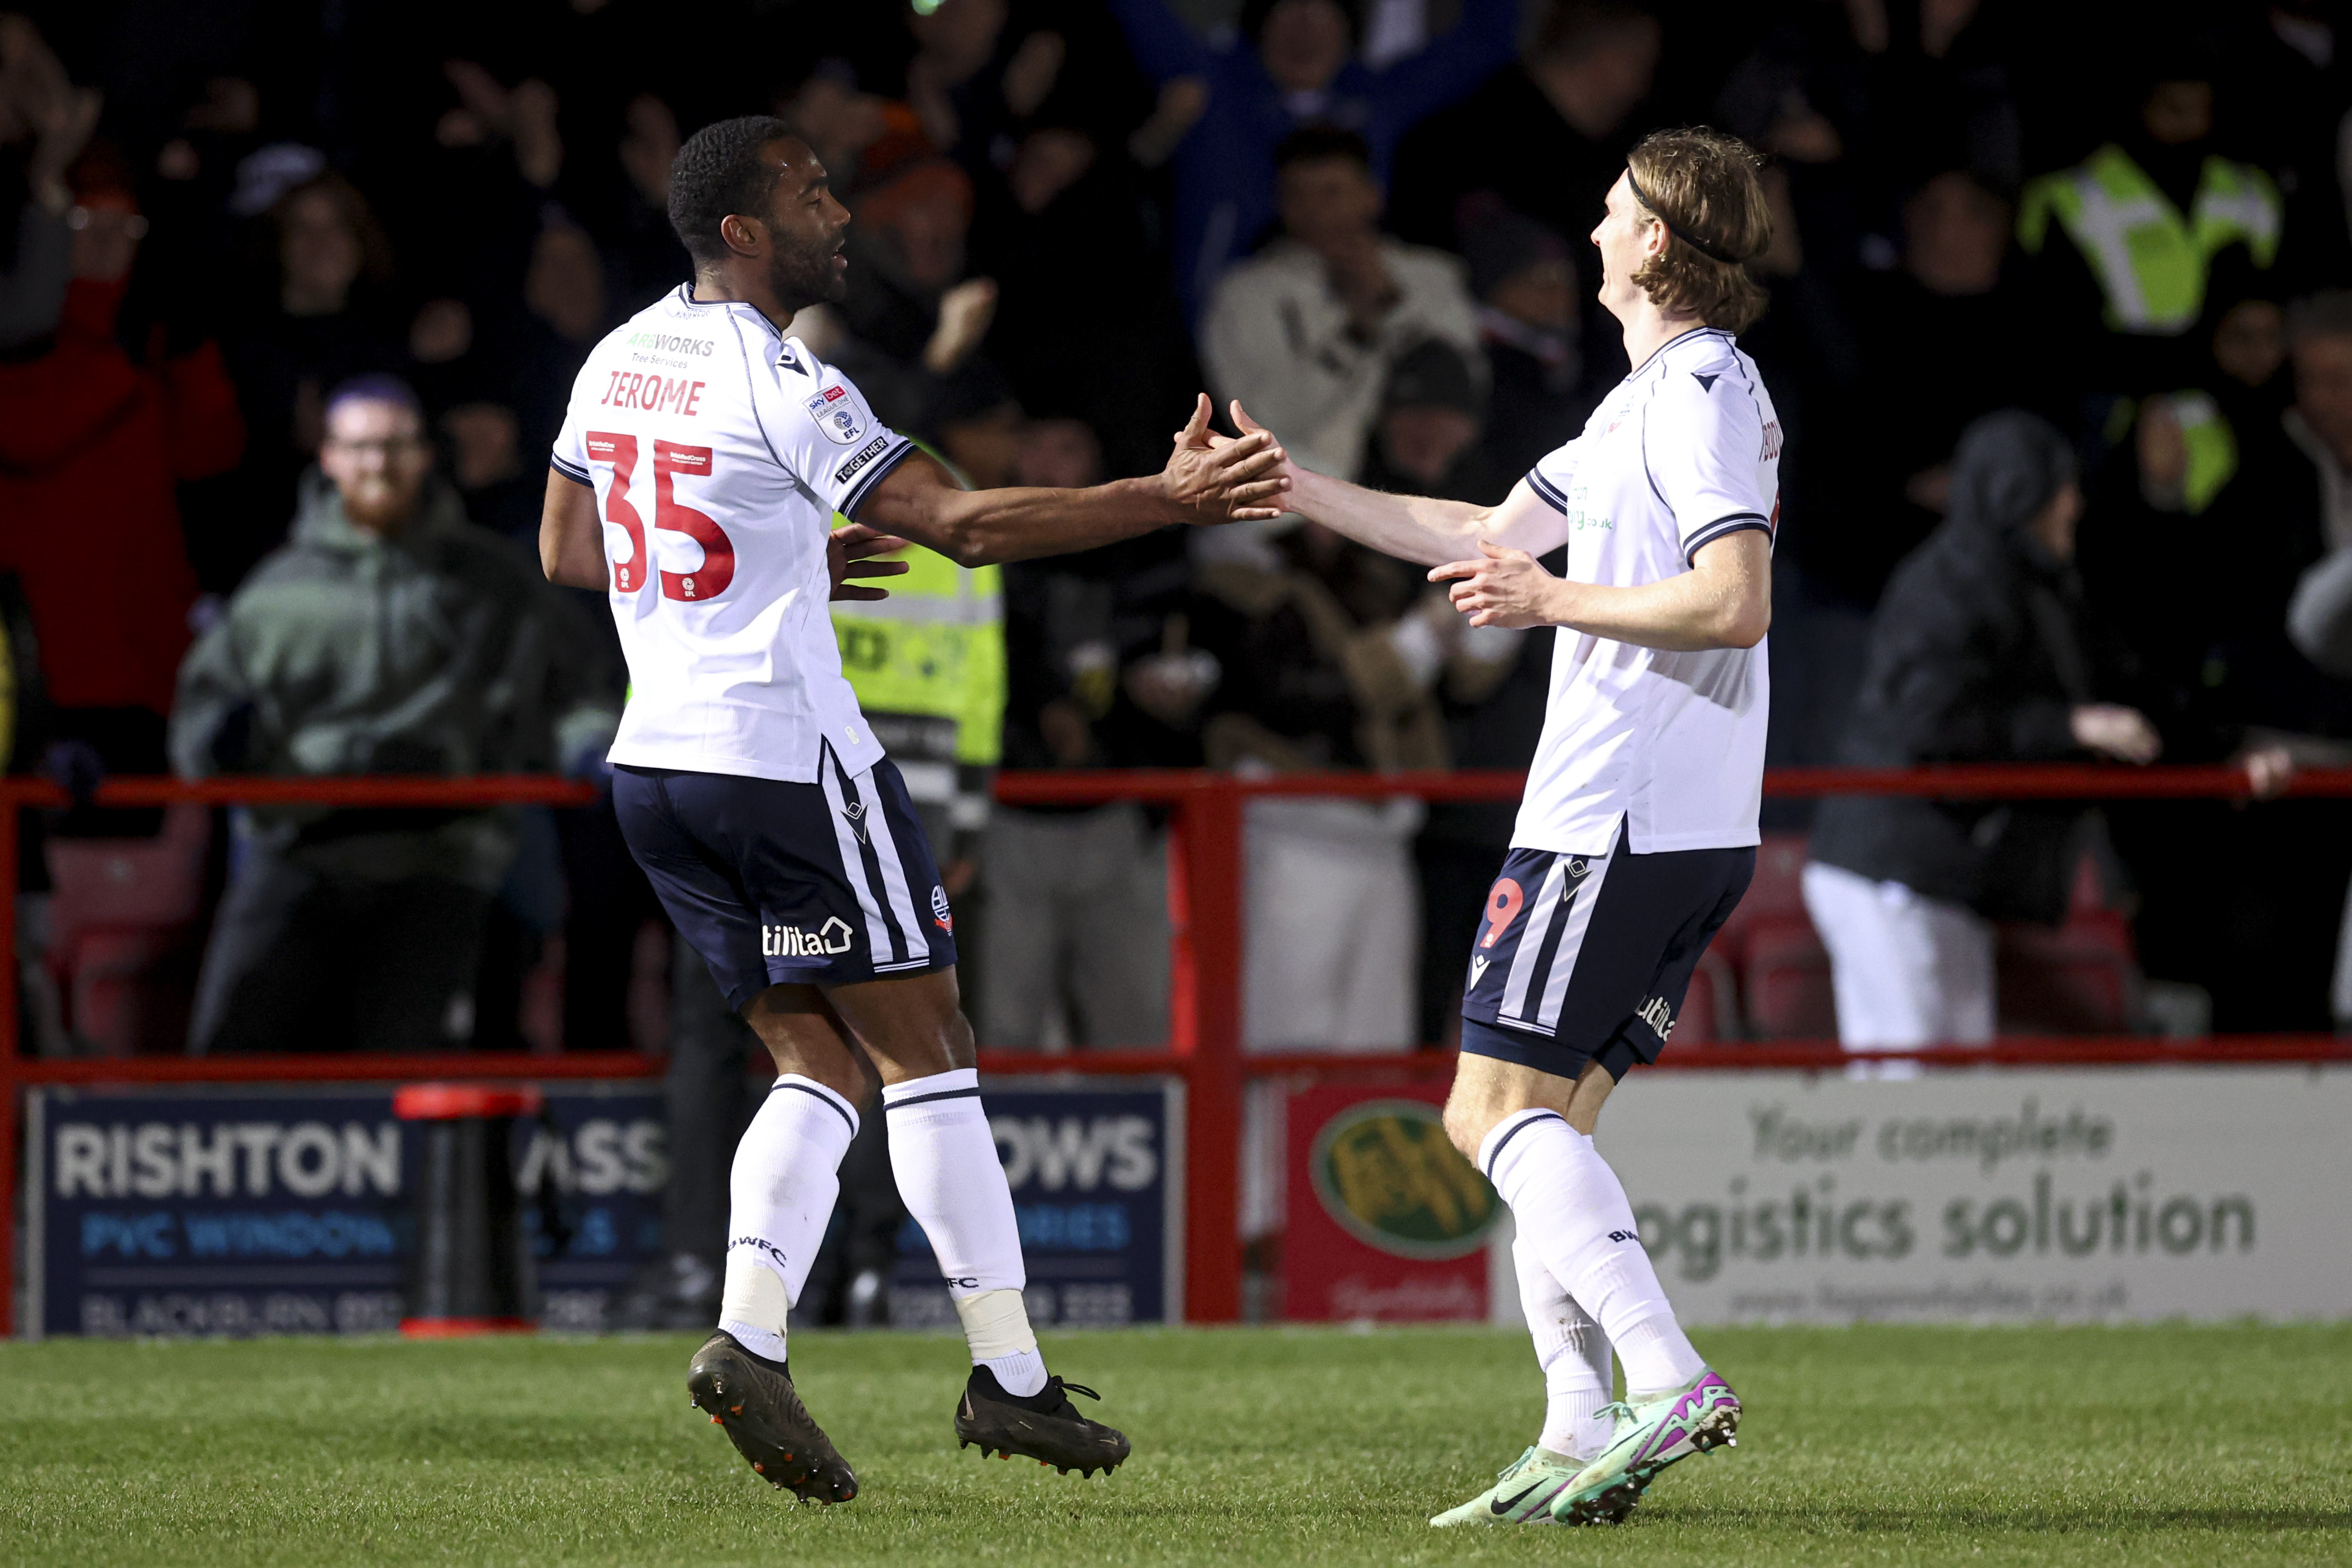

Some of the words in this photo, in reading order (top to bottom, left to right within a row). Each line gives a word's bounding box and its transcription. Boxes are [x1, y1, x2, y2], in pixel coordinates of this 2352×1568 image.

[626, 332, 714, 356] ARBWORKS
[632, 353, 648, 363] Tree
[650, 355, 688, 369] Services
[601, 370, 705, 416] JEROME
[809, 397, 825, 409] sky
[825, 388, 842, 399] bet
[816, 402, 838, 418] LEAGUE
[838, 395, 850, 406] ONE
[844, 427, 860, 439] EFL
[586, 431, 735, 602] 35
[1480, 877, 1524, 948] 9
[1748, 1101, 1861, 1162] Your
[1878, 1097, 2114, 1176] complete
[55, 1123, 402, 1198] RISHTON
[1943, 1170, 2256, 1258] solution
[727, 1237, 787, 1268] BWFC
